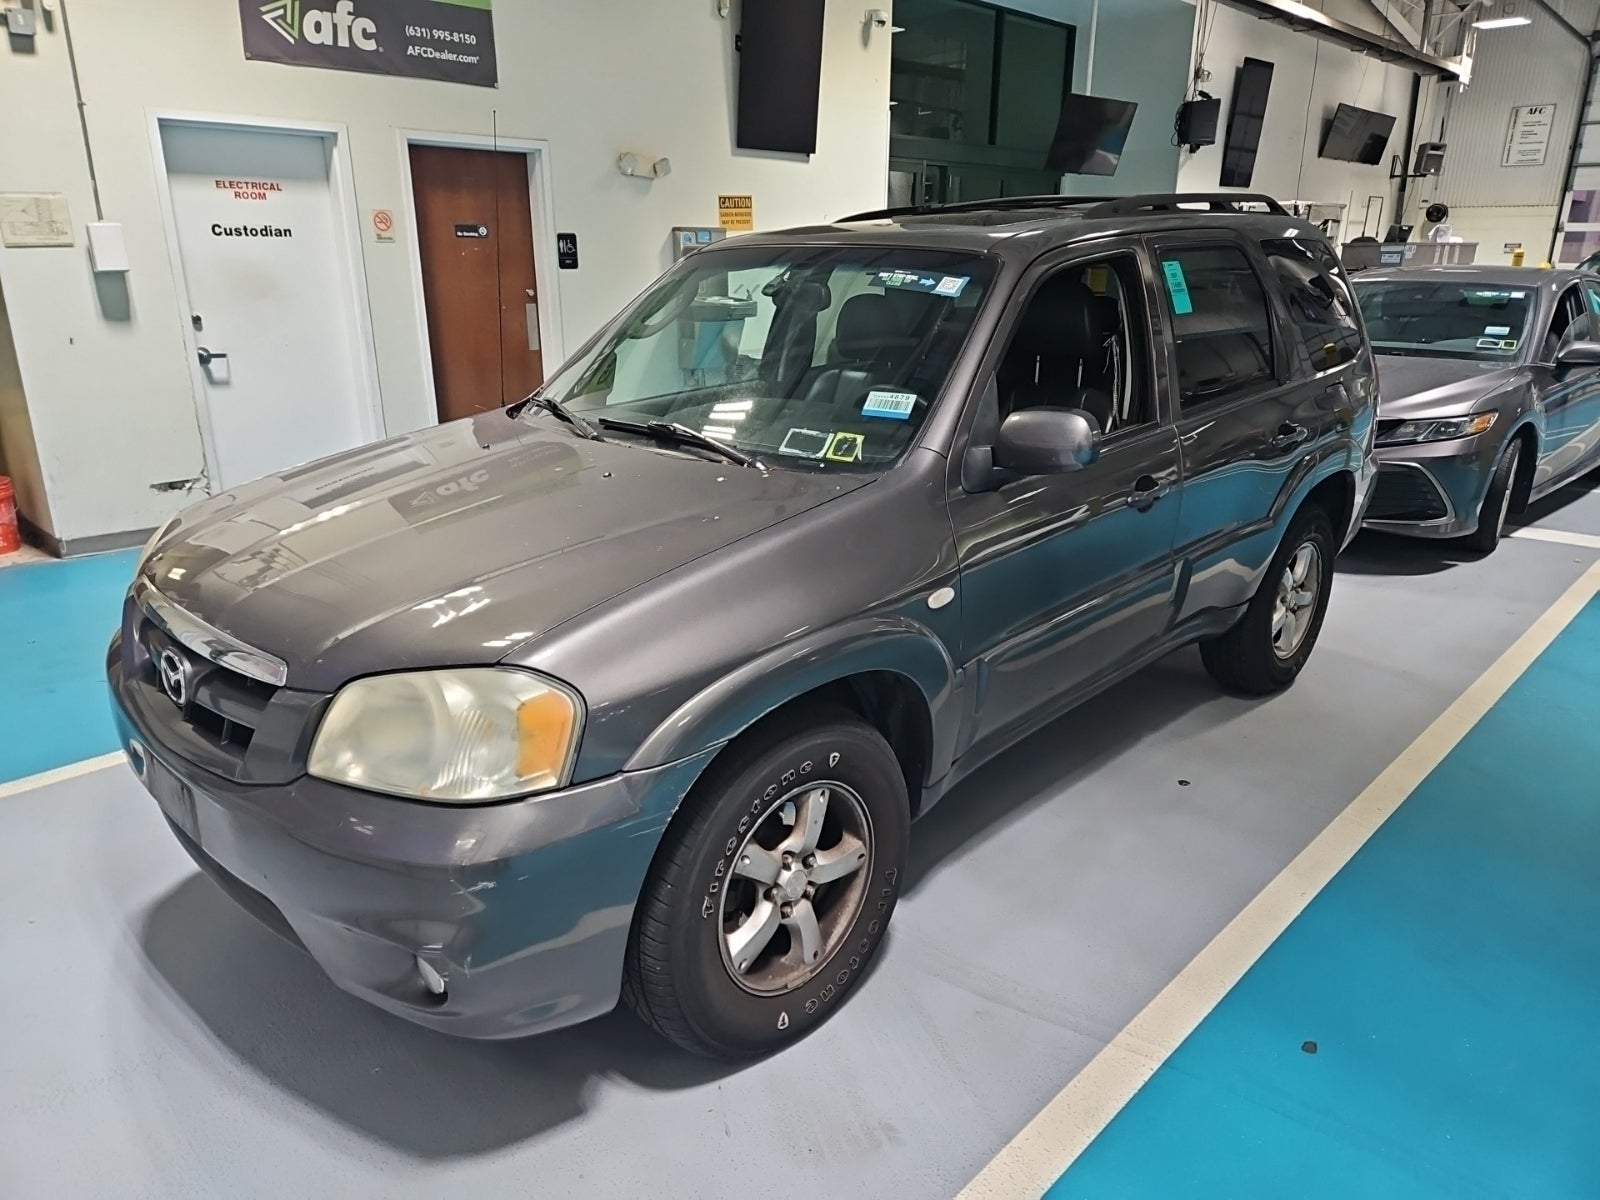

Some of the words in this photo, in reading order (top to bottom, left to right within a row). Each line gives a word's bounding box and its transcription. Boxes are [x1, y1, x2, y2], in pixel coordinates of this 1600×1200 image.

[405, 25, 431, 40] (631)
[432, 28, 477, 45] 995-8150
[1527, 107, 1546, 115] AFC
[215, 180, 282, 191] ELECTRICAL
[234, 191, 267, 200] ROOM
[720, 197, 751, 208] CAUTION
[211, 223, 293, 238] Custodian
